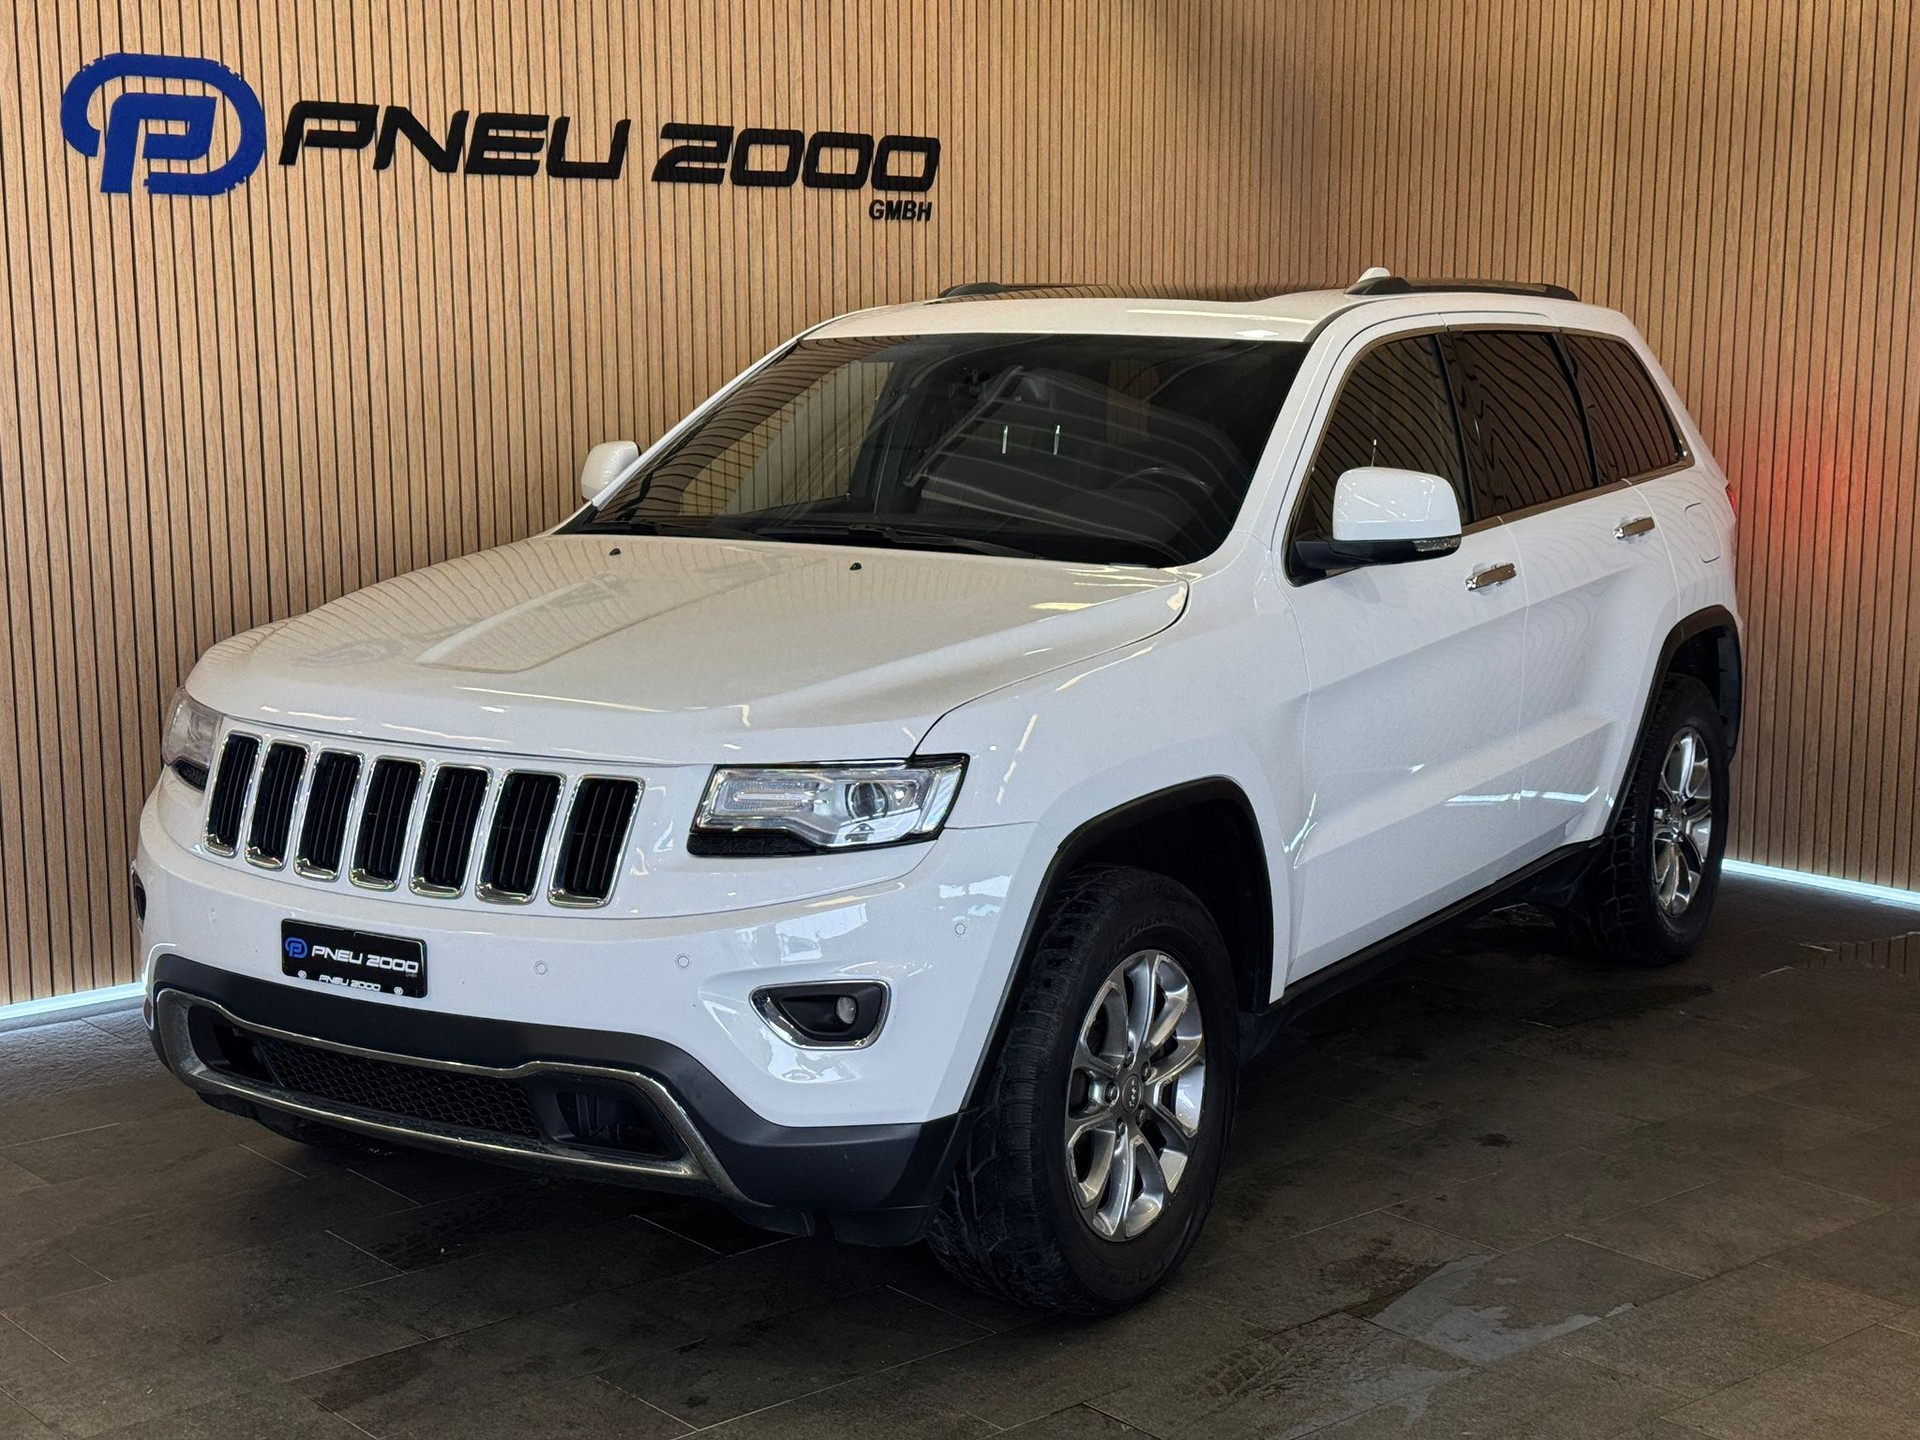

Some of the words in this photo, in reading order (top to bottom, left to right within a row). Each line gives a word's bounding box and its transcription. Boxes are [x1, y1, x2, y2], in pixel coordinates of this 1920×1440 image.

[279, 100, 631, 179] PNEU
[651, 122, 941, 192] 2000
[868, 199, 932, 221] GMBH
[311, 945, 363, 964] PNEU
[366, 954, 419, 973] 2000
[319, 974, 349, 986] PNEU
[350, 979, 381, 992] 2000
